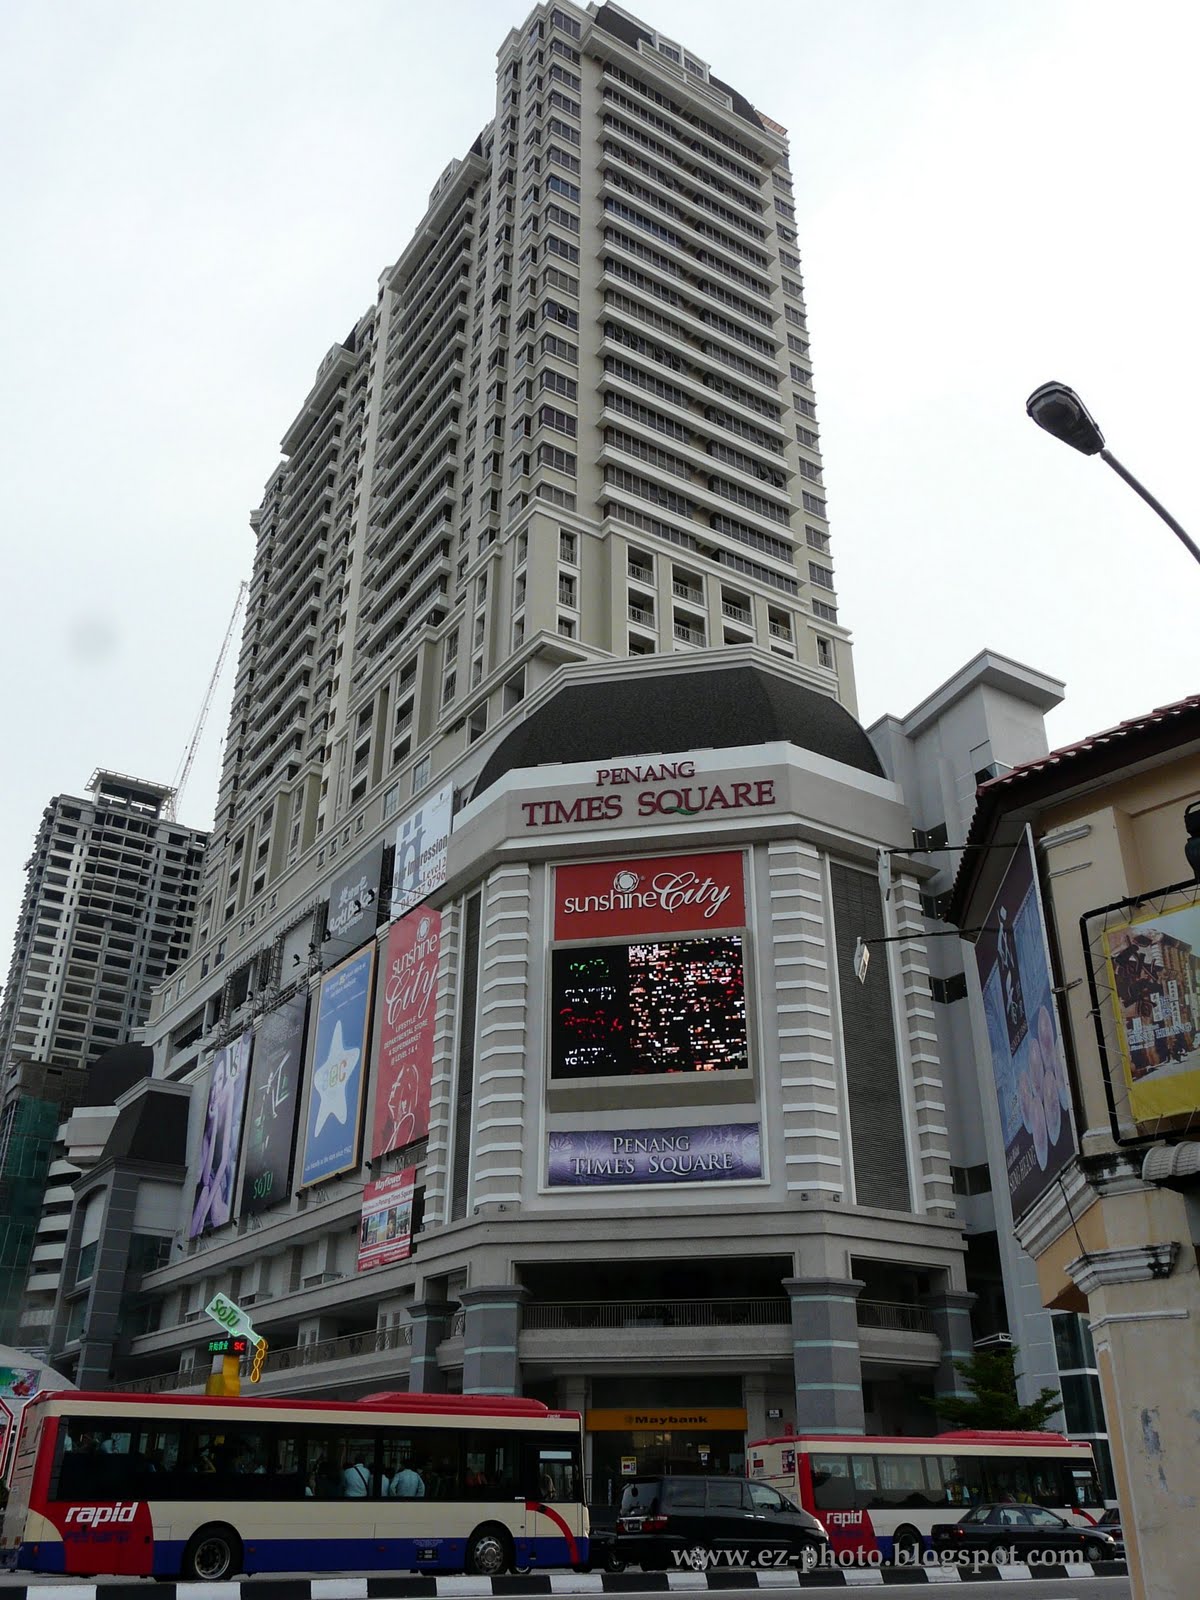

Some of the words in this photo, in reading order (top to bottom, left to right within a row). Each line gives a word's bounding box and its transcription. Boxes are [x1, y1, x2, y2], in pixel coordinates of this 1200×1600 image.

[596, 761, 695, 786] PENANG
[522, 795, 622, 826] TIMES
[638, 780, 776, 816] SQUARE
[564, 888, 657, 915] sunshine
[653, 871, 731, 918] City
[392, 932, 438, 972] sunshine
[385, 962, 438, 1029] City
[613, 1136, 690, 1154] PENANG
[571, 1157, 635, 1176] TIMES
[648, 1152, 733, 1176] SQUARE
[211, 1299, 240, 1327] SOJU
[635, 1415, 708, 1425] Maybank
[65, 1502, 139, 1528] rapid
[826, 1510, 863, 1528] rapid
